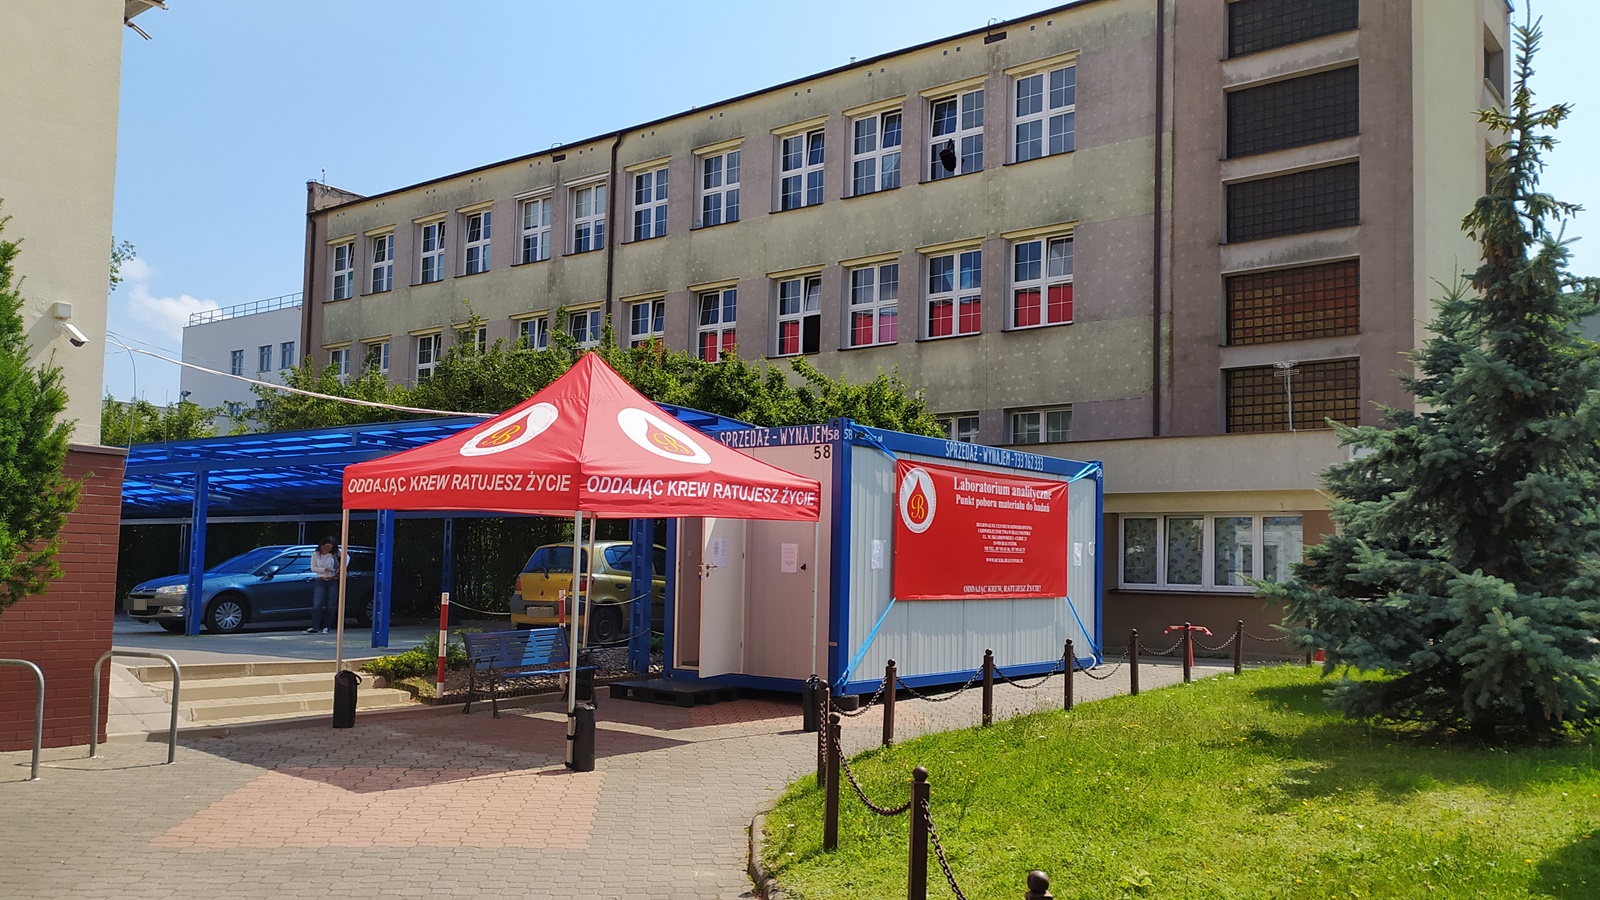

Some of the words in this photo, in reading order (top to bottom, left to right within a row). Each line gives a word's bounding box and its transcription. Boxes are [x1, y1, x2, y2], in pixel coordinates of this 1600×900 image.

[780, 425, 829, 445] WYNAJEM
[828, 429, 840, 441] 58
[843, 428, 853, 440] 58
[813, 444, 831, 460] 58
[945, 441, 978, 461] SPRZEDAŻ
[982, 447, 1010, 466] WYNAJEM
[348, 478, 407, 496] ODDAJĄC
[409, 474, 450, 491] KREW
[451, 474, 523, 491] RATUJESZ
[526, 471, 571, 491] ŻYCIE
[586, 475, 664, 500] ODDAJĄC
[667, 480, 711, 498] KREW
[712, 482, 778, 504] RATUJESZ
[780, 486, 816, 507] ŻYCIE
[953, 477, 1010, 496] Laboratorium
[1011, 485, 1052, 502] analityczne
[955, 494, 975, 506] Punkt
[975, 497, 998, 509] poboru
[1025, 501, 1034, 512] do
[1033, 502, 1050, 512] badań
